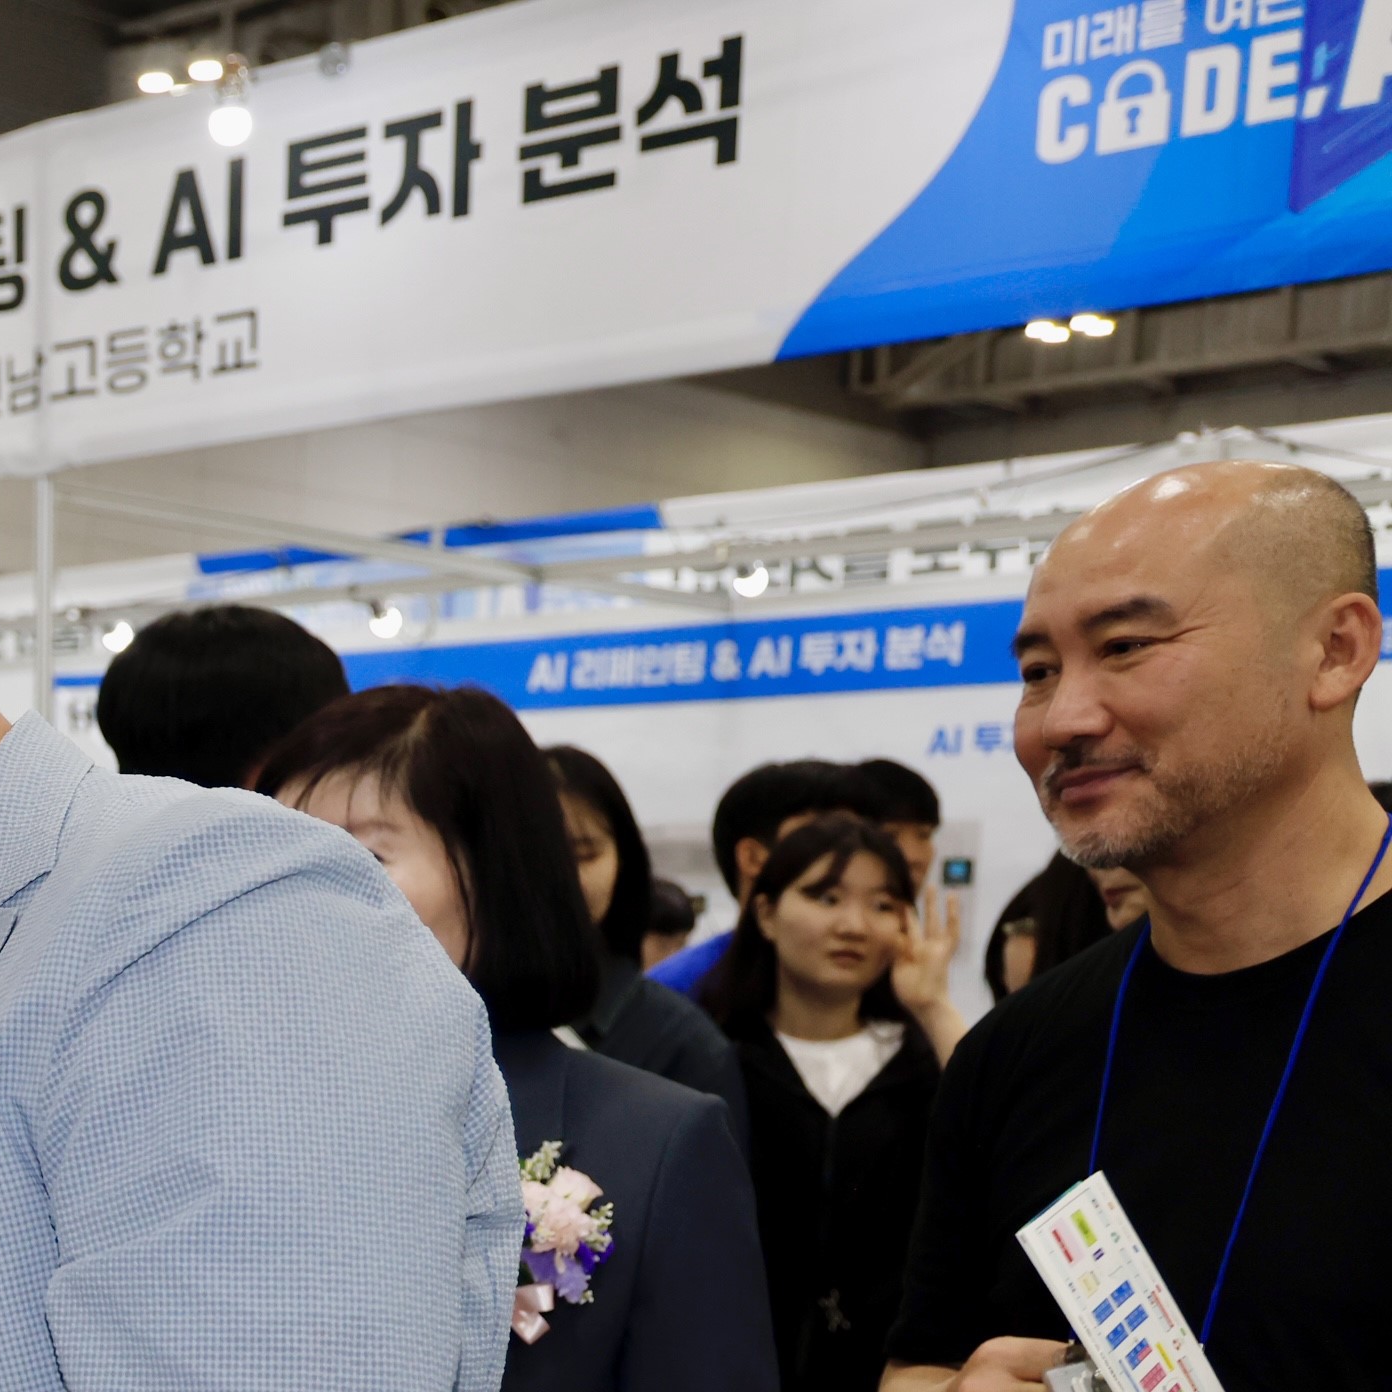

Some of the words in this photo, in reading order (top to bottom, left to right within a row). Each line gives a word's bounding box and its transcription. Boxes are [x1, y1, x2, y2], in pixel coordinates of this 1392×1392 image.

[1041, 0, 1186, 71] 미래를
[58, 188, 119, 291] &
[153, 157, 245, 275] AI
[283, 98, 483, 246] 투자
[519, 35, 742, 204] 분석
[526, 653, 568, 694] AI
[712, 638, 741, 682] &
[747, 635, 793, 680] AI
[798, 626, 878, 677] 투자
[883, 621, 966, 671] 분석
